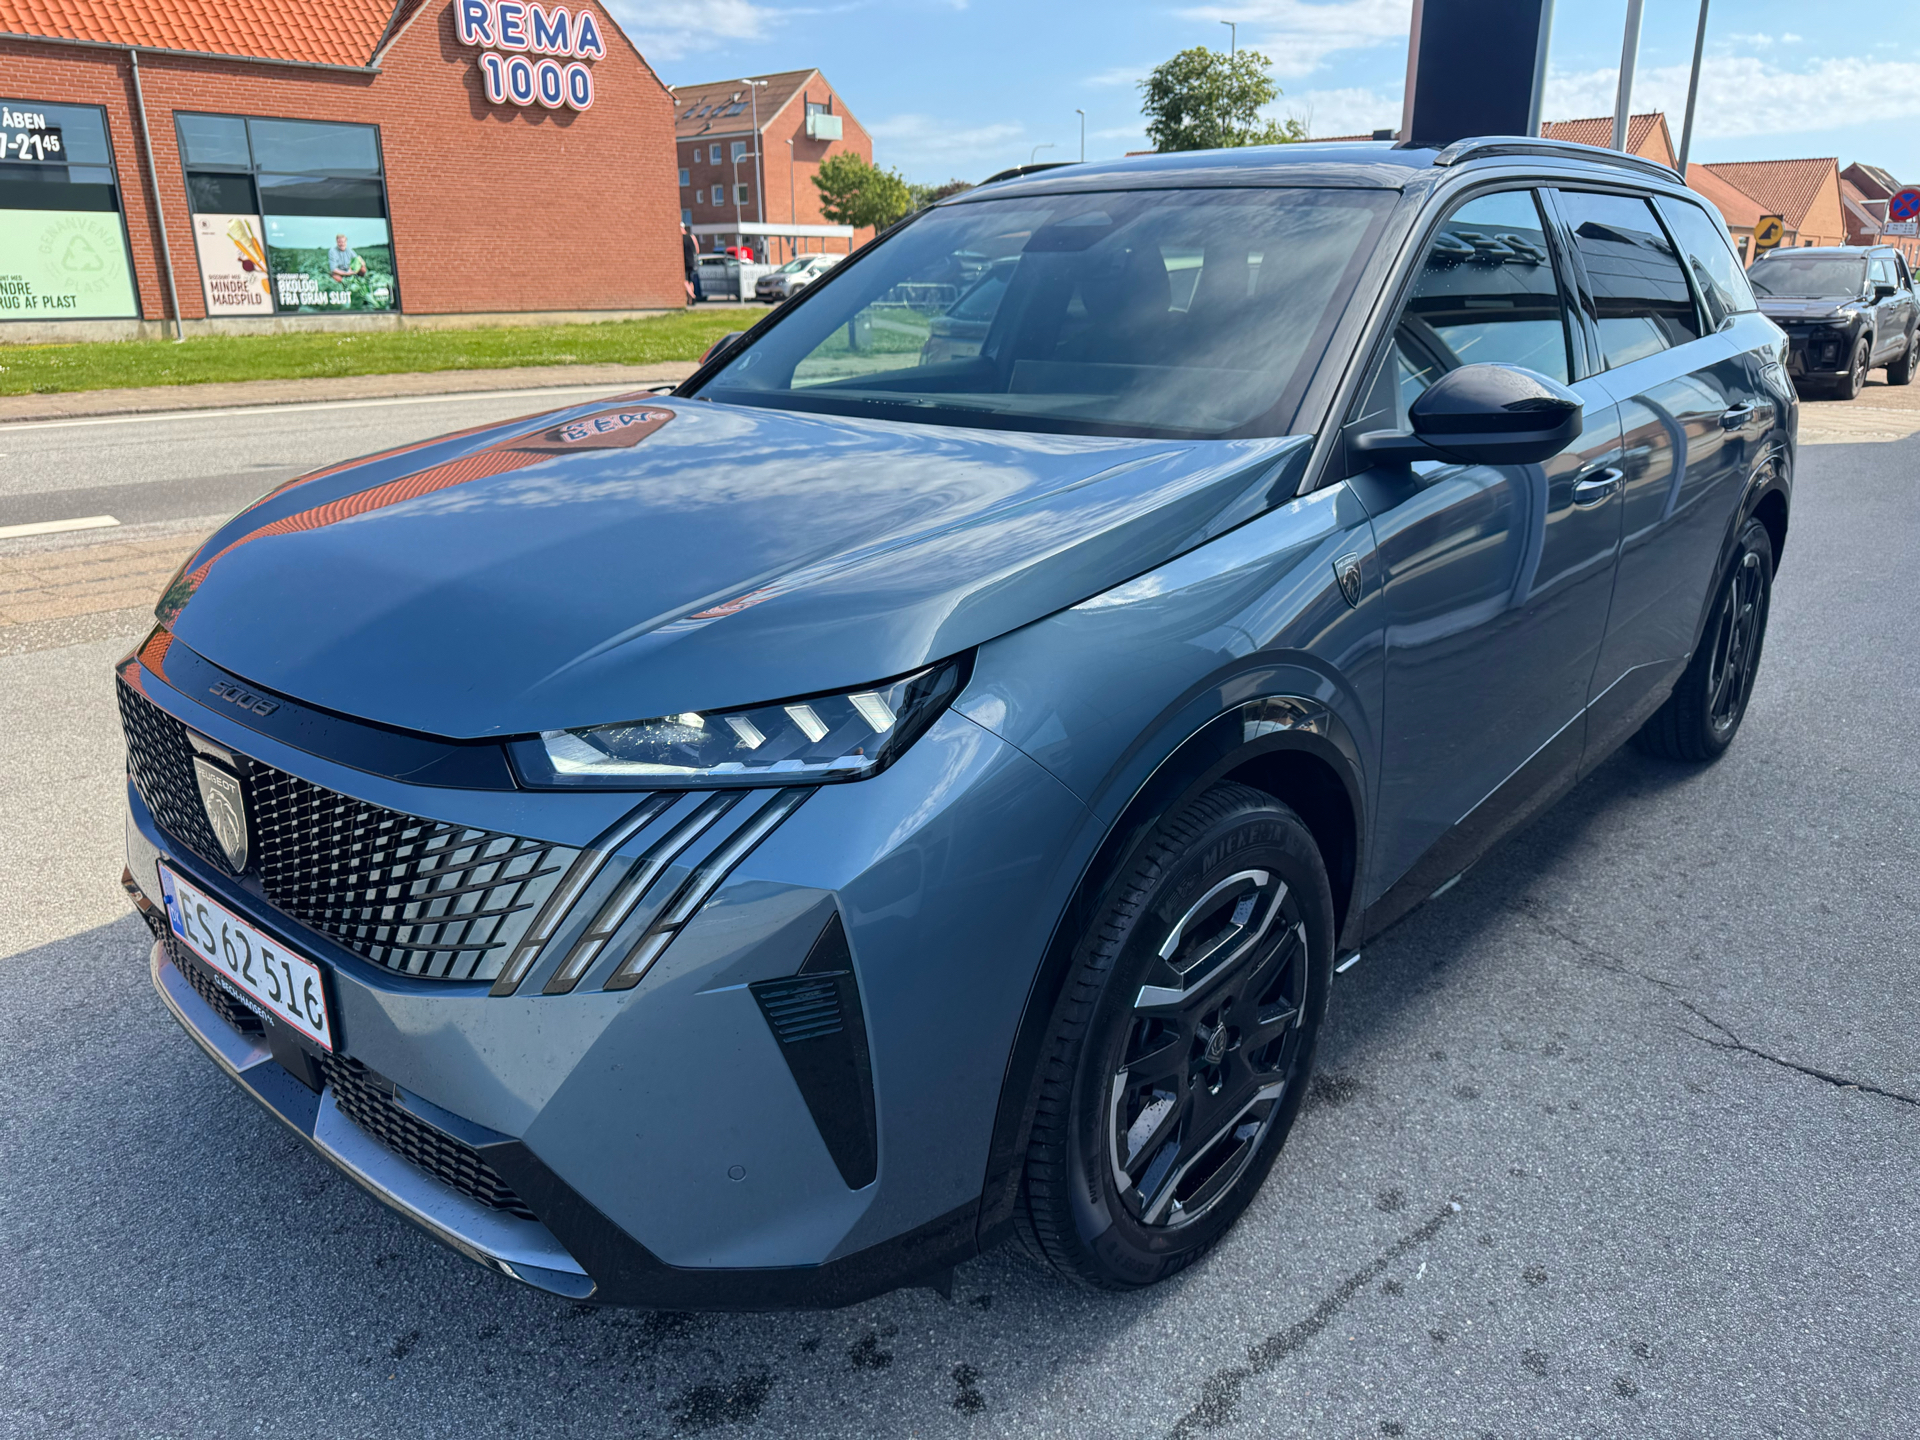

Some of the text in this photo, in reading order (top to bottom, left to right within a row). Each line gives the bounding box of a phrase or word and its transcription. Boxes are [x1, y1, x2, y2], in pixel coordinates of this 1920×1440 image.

[455, 0, 607, 60] REMA
[479, 52, 594, 111] 1000
[2, 107, 45, 130] ÅBEN
[64, 277, 110, 294] PLAST
[210, 281, 249, 293] MINDRE
[277, 280, 318, 293] ØKOLOGI
[25, 295, 38, 309] AF
[42, 295, 76, 309] PLAST
[212, 293, 262, 305] MADSPILD
[280, 292, 300, 305] FRA
[329, 291, 352, 304] SLOT
[209, 680, 280, 716] 5008
[197, 767, 236, 793] PEUGEOT
[1202, 823, 1283, 875] MICHELIN
[179, 888, 323, 1031] ES 62 516
